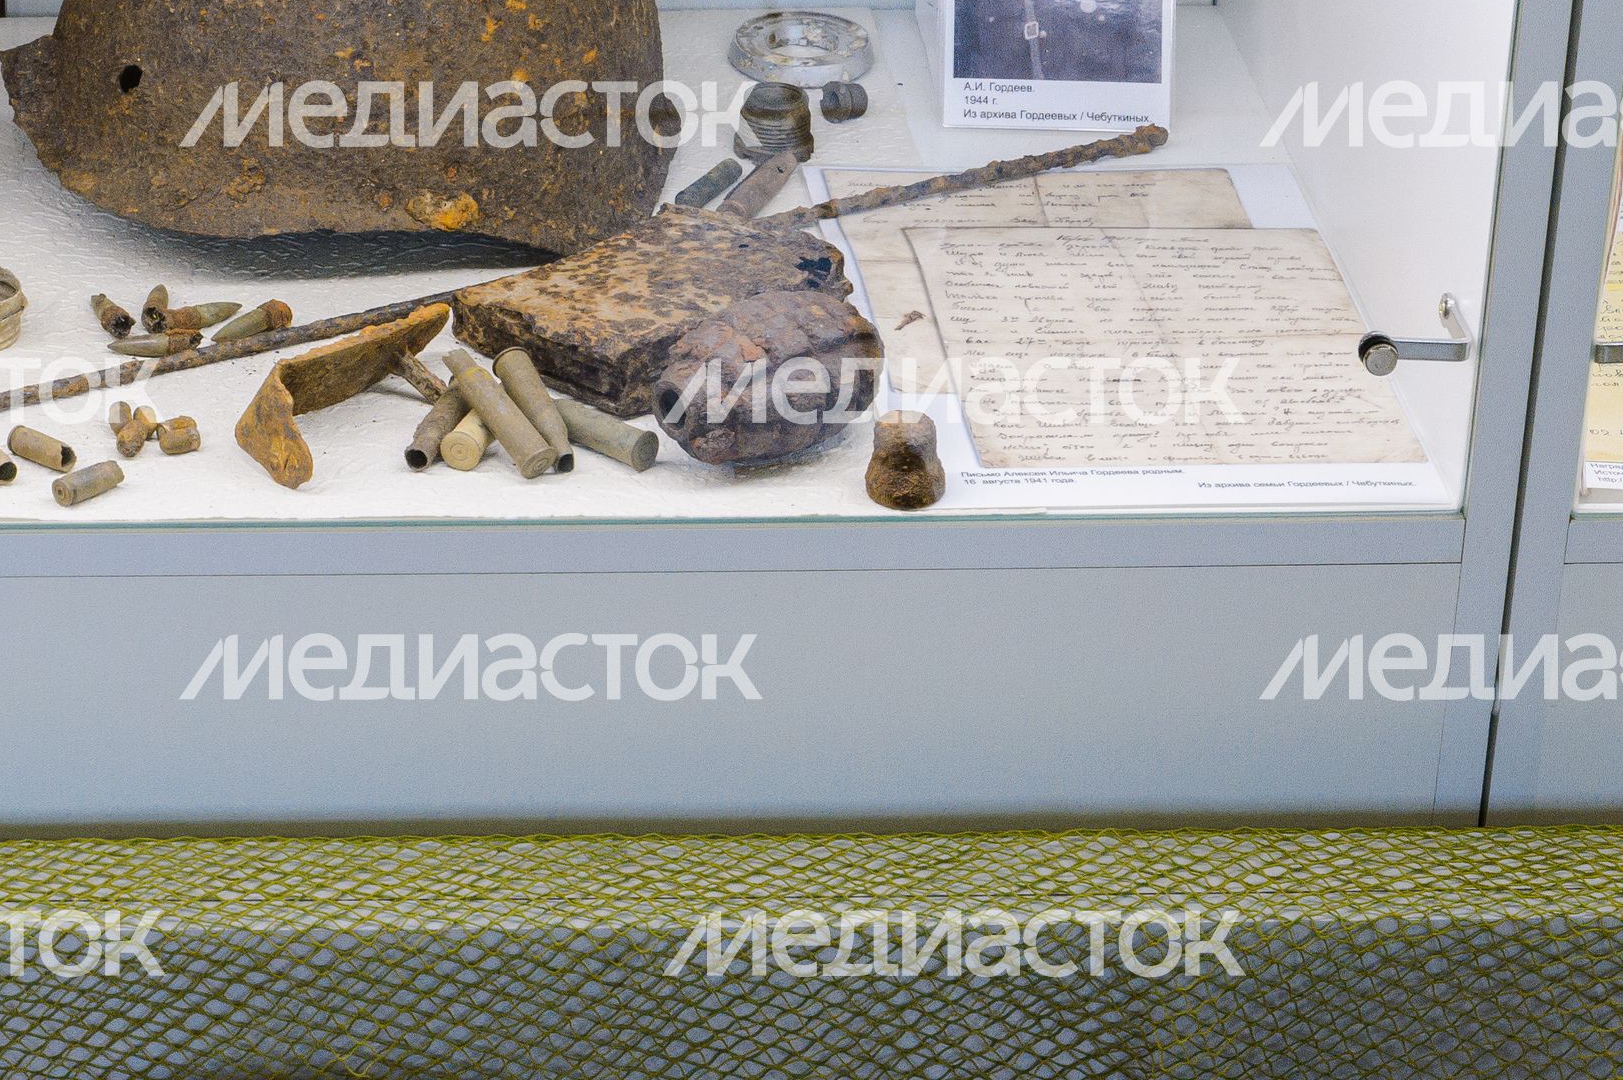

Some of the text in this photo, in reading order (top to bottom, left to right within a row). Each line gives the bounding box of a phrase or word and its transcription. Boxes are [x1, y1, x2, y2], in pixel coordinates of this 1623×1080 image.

[964, 81, 1035, 94] А.И. Гордеев.
[965, 95, 989, 105] 1944
[963, 109, 977, 119] Из
[980, 111, 1017, 121] архива
[1020, 110, 1077, 122] Гордеевых
[1087, 112, 1153, 124] Чебуткиных.
